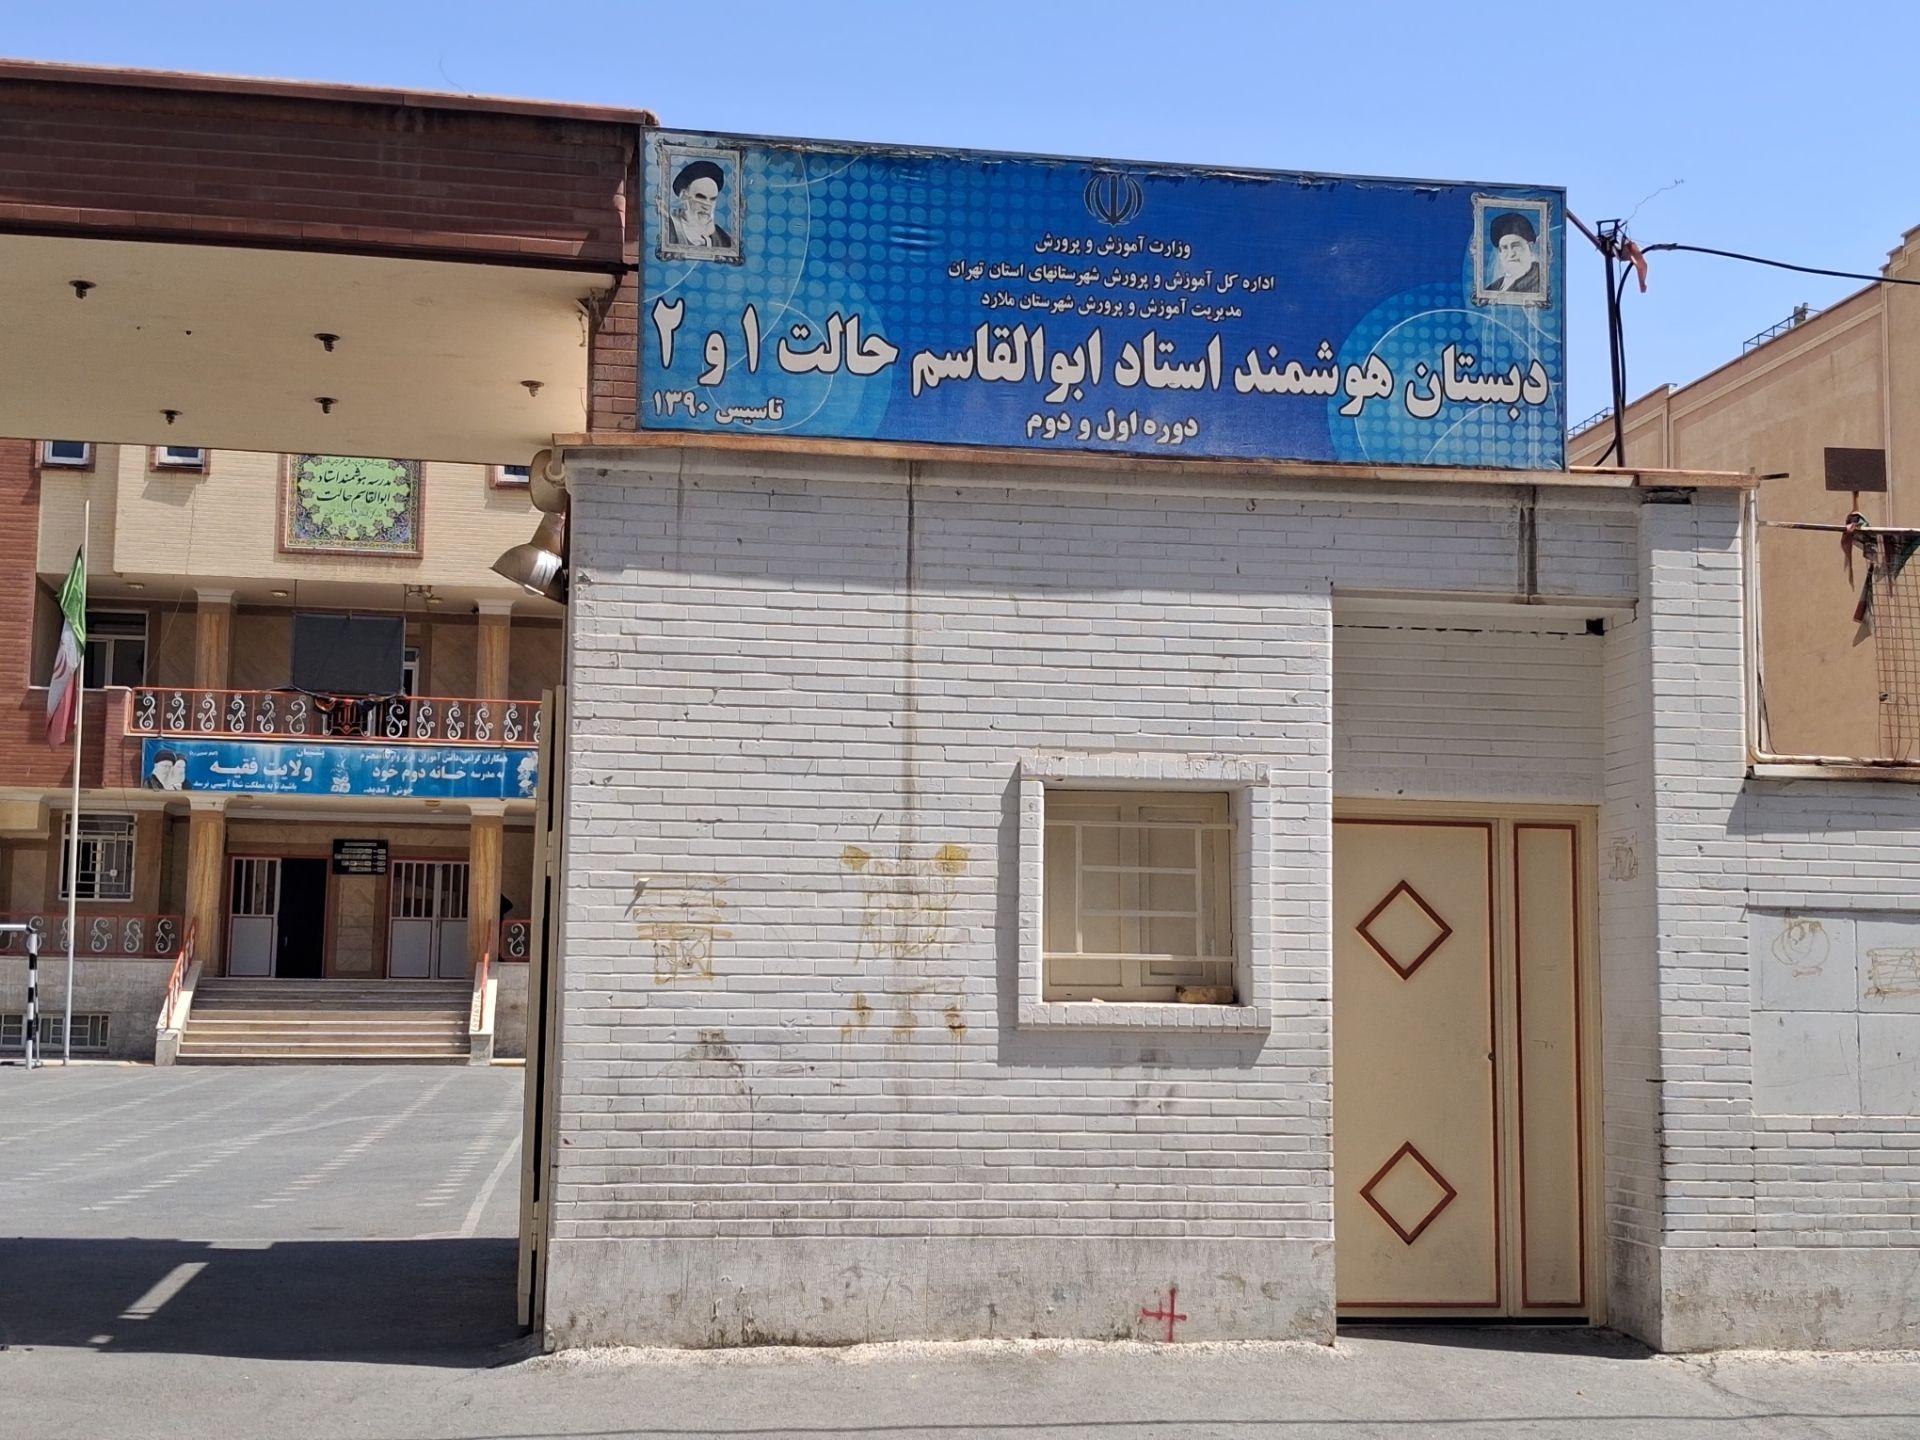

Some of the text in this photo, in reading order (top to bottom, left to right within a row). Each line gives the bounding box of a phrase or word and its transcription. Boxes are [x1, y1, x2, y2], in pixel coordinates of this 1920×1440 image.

[1035, 233, 1191, 259] وزارت آموزش و پرورش
[948, 260, 1275, 294] اداره کل آموزش و پرورش شهرستانهای استان تهران
[981, 291, 1242, 322] مدیریت آموزش و پرورش شهرستان ملارد
[652, 297, 1548, 421] دبستان هوشمند استاد ابوالقاسم حالت ۱ و ۲
[653, 390, 784, 424] تاسیس ۱۳۹۰
[1026, 408, 1198, 444] دوره اول و دوم
[317, 467, 391, 487] مدرسه هوشمند استاد
[316, 487, 391, 513] ابوالقاسم حالت
[210, 756, 313, 782] ولایت فقیه
[372, 766, 398, 782] خود
[402, 768, 425, 783] دوم
[429, 766, 466, 780] خانه
[470, 770, 495, 781] مدرسه
